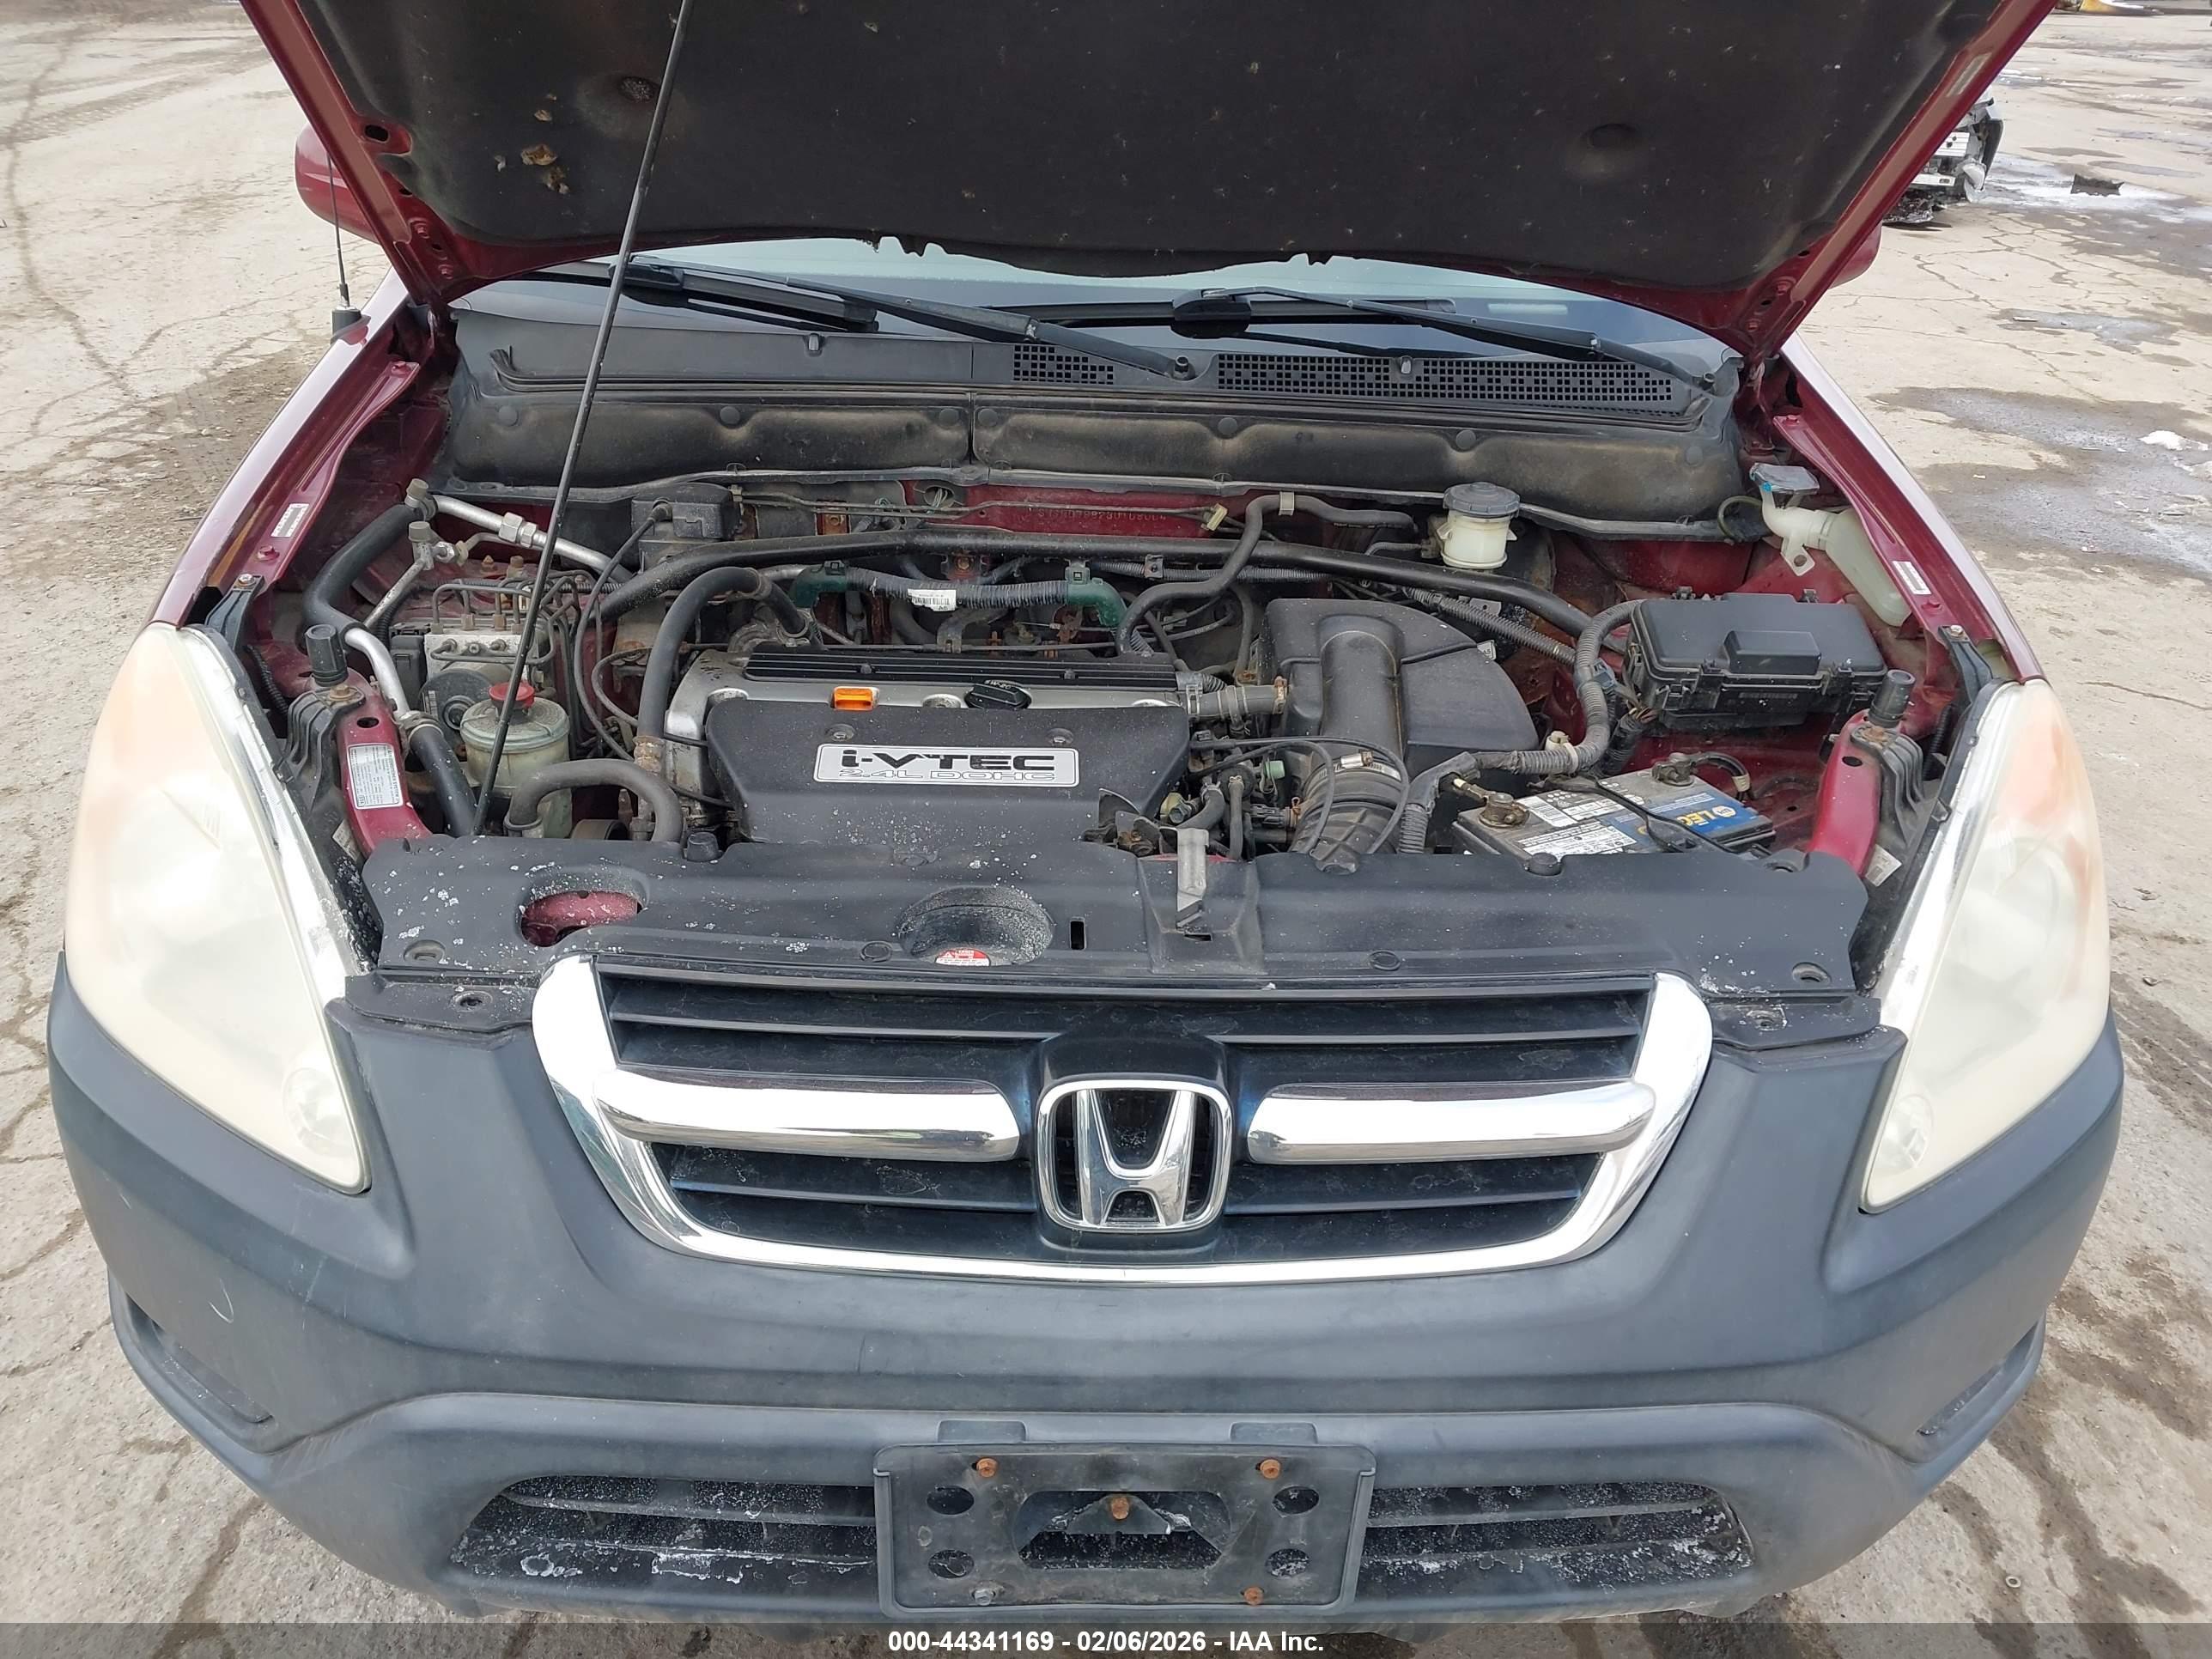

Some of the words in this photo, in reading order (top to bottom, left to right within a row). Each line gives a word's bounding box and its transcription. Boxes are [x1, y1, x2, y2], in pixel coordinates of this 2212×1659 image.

[842, 749, 1055, 771] i-VTEC
[838, 768, 923, 779] 2.4L
[929, 769, 1056, 781] DOHC
